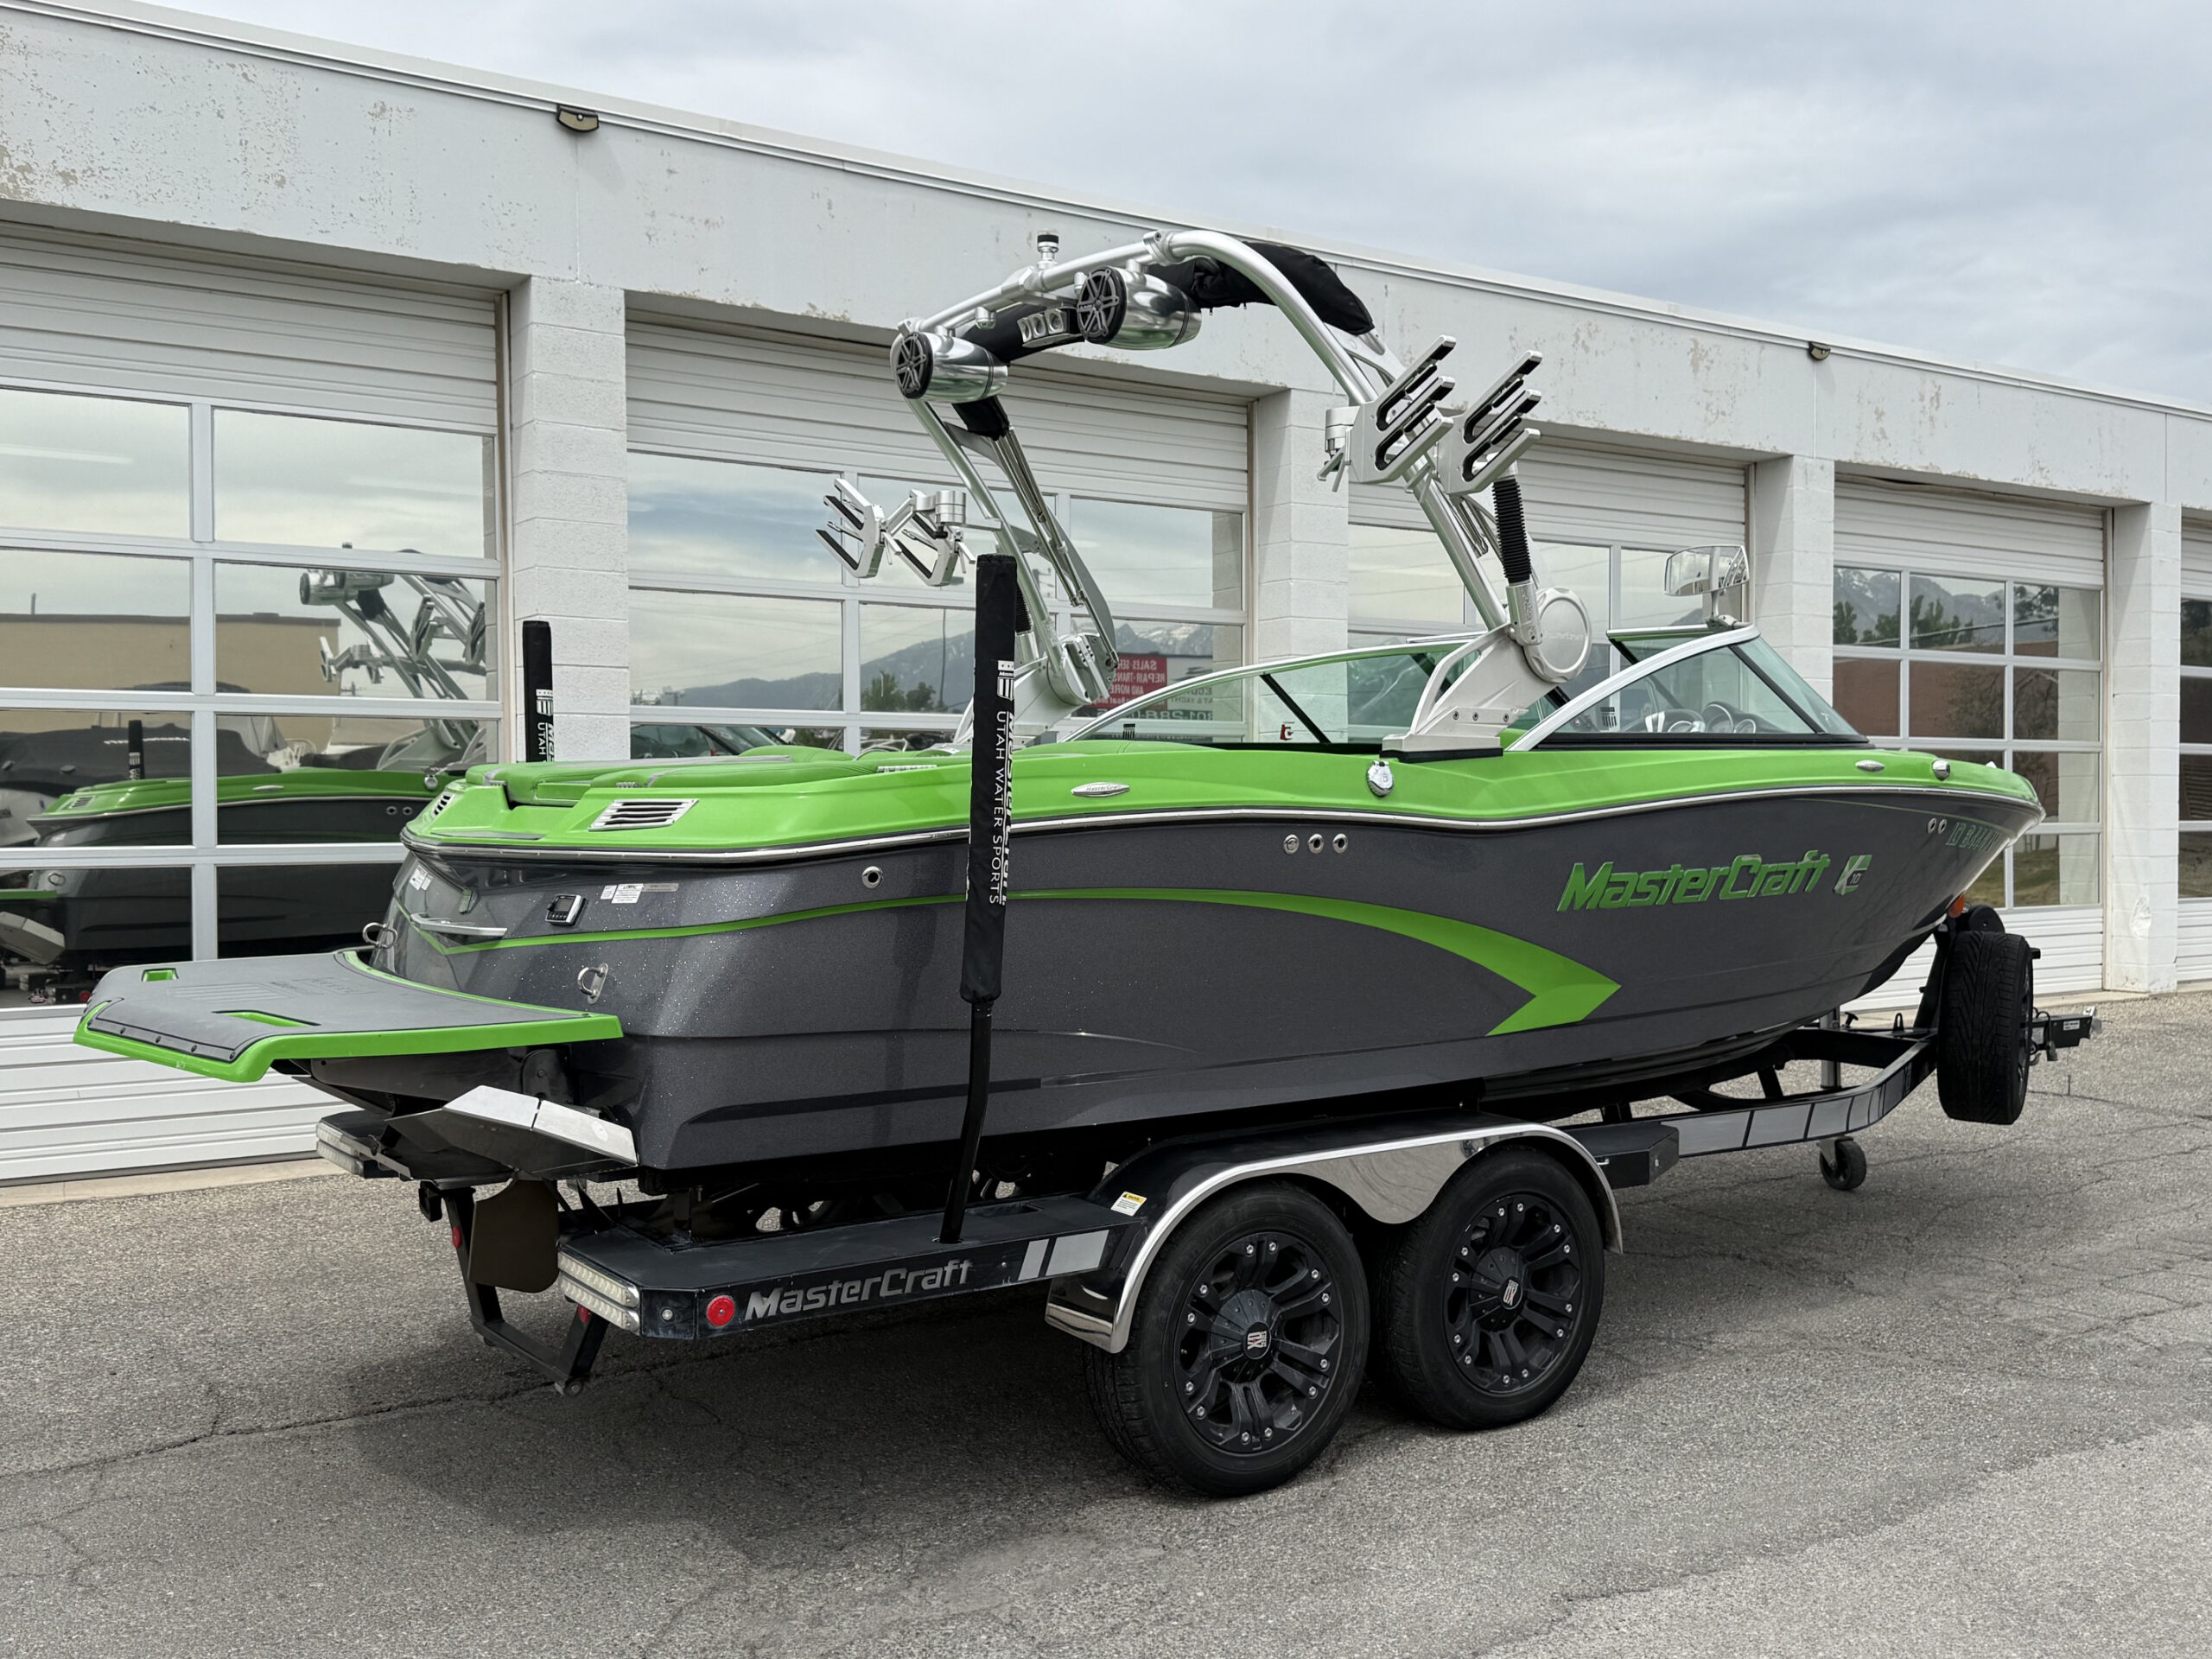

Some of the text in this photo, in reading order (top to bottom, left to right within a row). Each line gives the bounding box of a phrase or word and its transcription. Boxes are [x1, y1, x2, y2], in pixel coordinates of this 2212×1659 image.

[537, 722, 547, 755] UTAH
[989, 711, 1007, 904] UTAH WATER SPORTS
[1557, 850, 1831, 912] MasterCraft
[744, 1259, 973, 1322] MasterCraft
